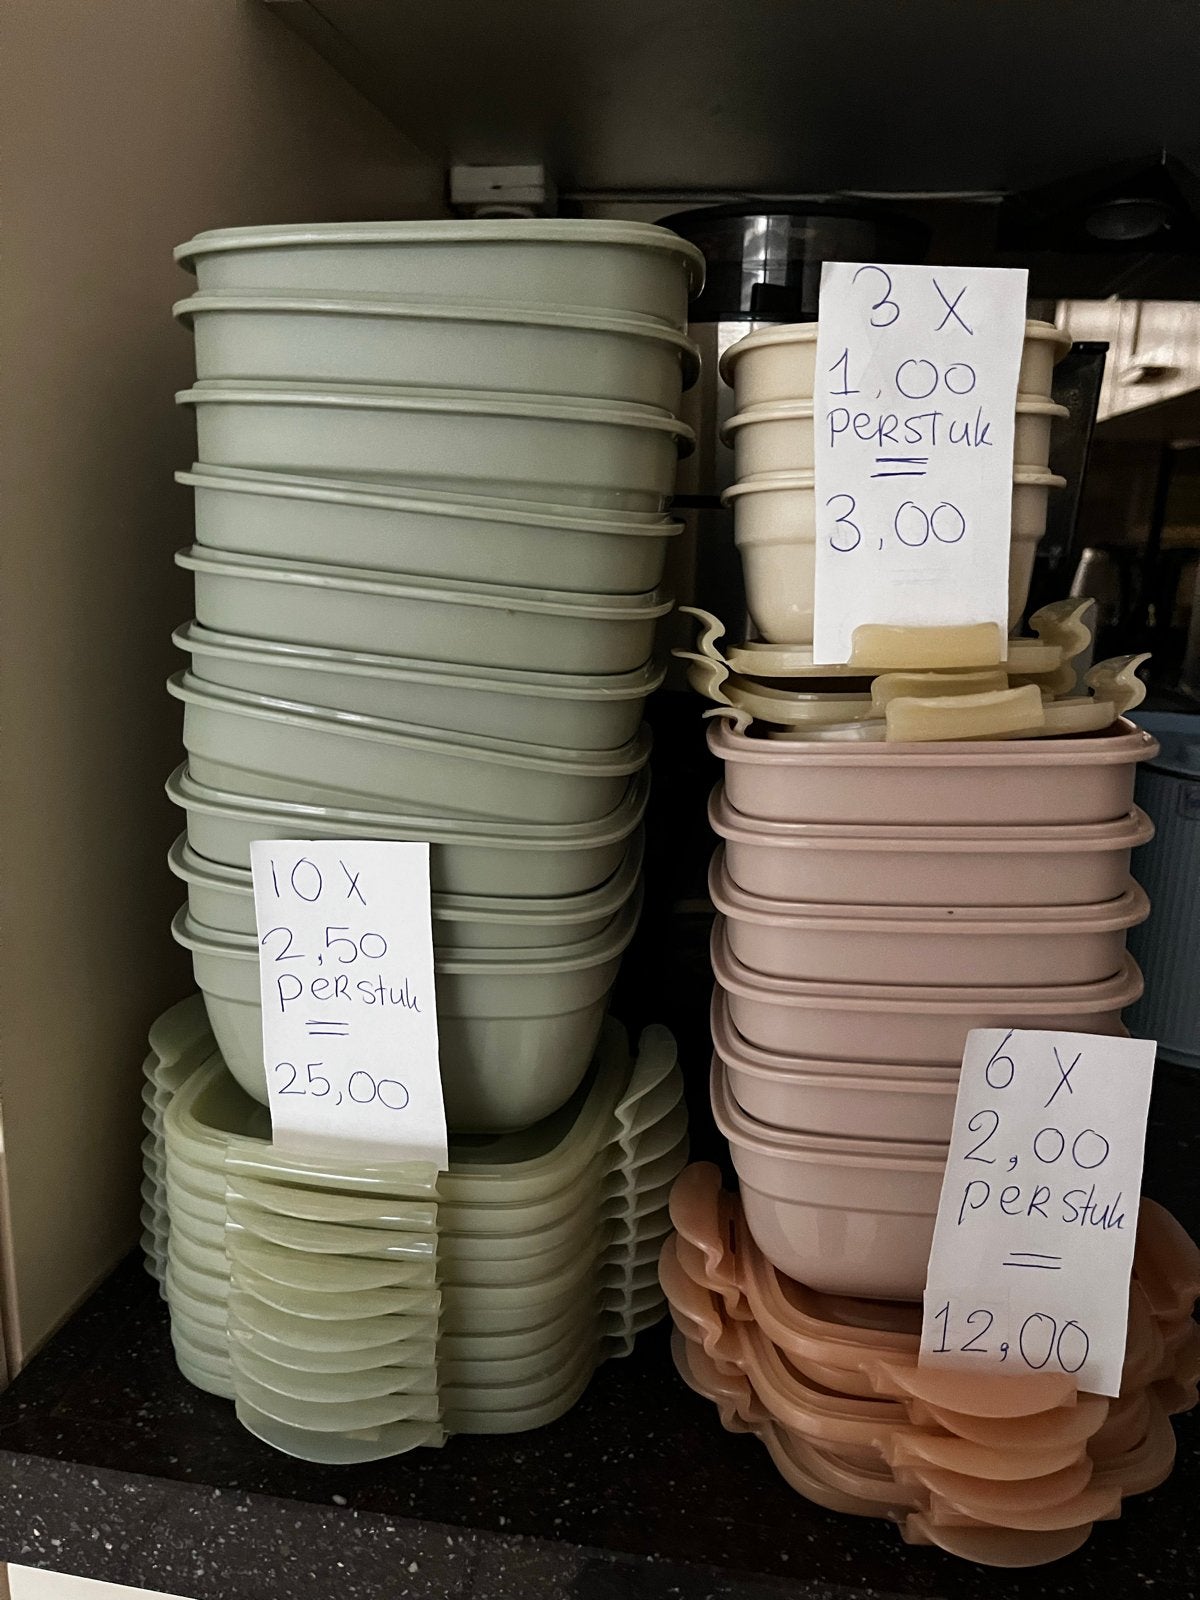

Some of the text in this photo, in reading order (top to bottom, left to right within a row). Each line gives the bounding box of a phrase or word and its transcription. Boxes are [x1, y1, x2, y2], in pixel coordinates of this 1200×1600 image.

[852, 265, 901, 328] 3
[828, 348, 977, 400] 1,00
[826, 494, 966, 552] 3,00
[270, 857, 323, 902] 10
[261, 927, 387, 965] 2,50
[274, 1062, 409, 1110] 25,00
[985, 1029, 1015, 1089] 6
[963, 1109, 1110, 1172] 2,00
[932, 1301, 1090, 1373] 12,00
